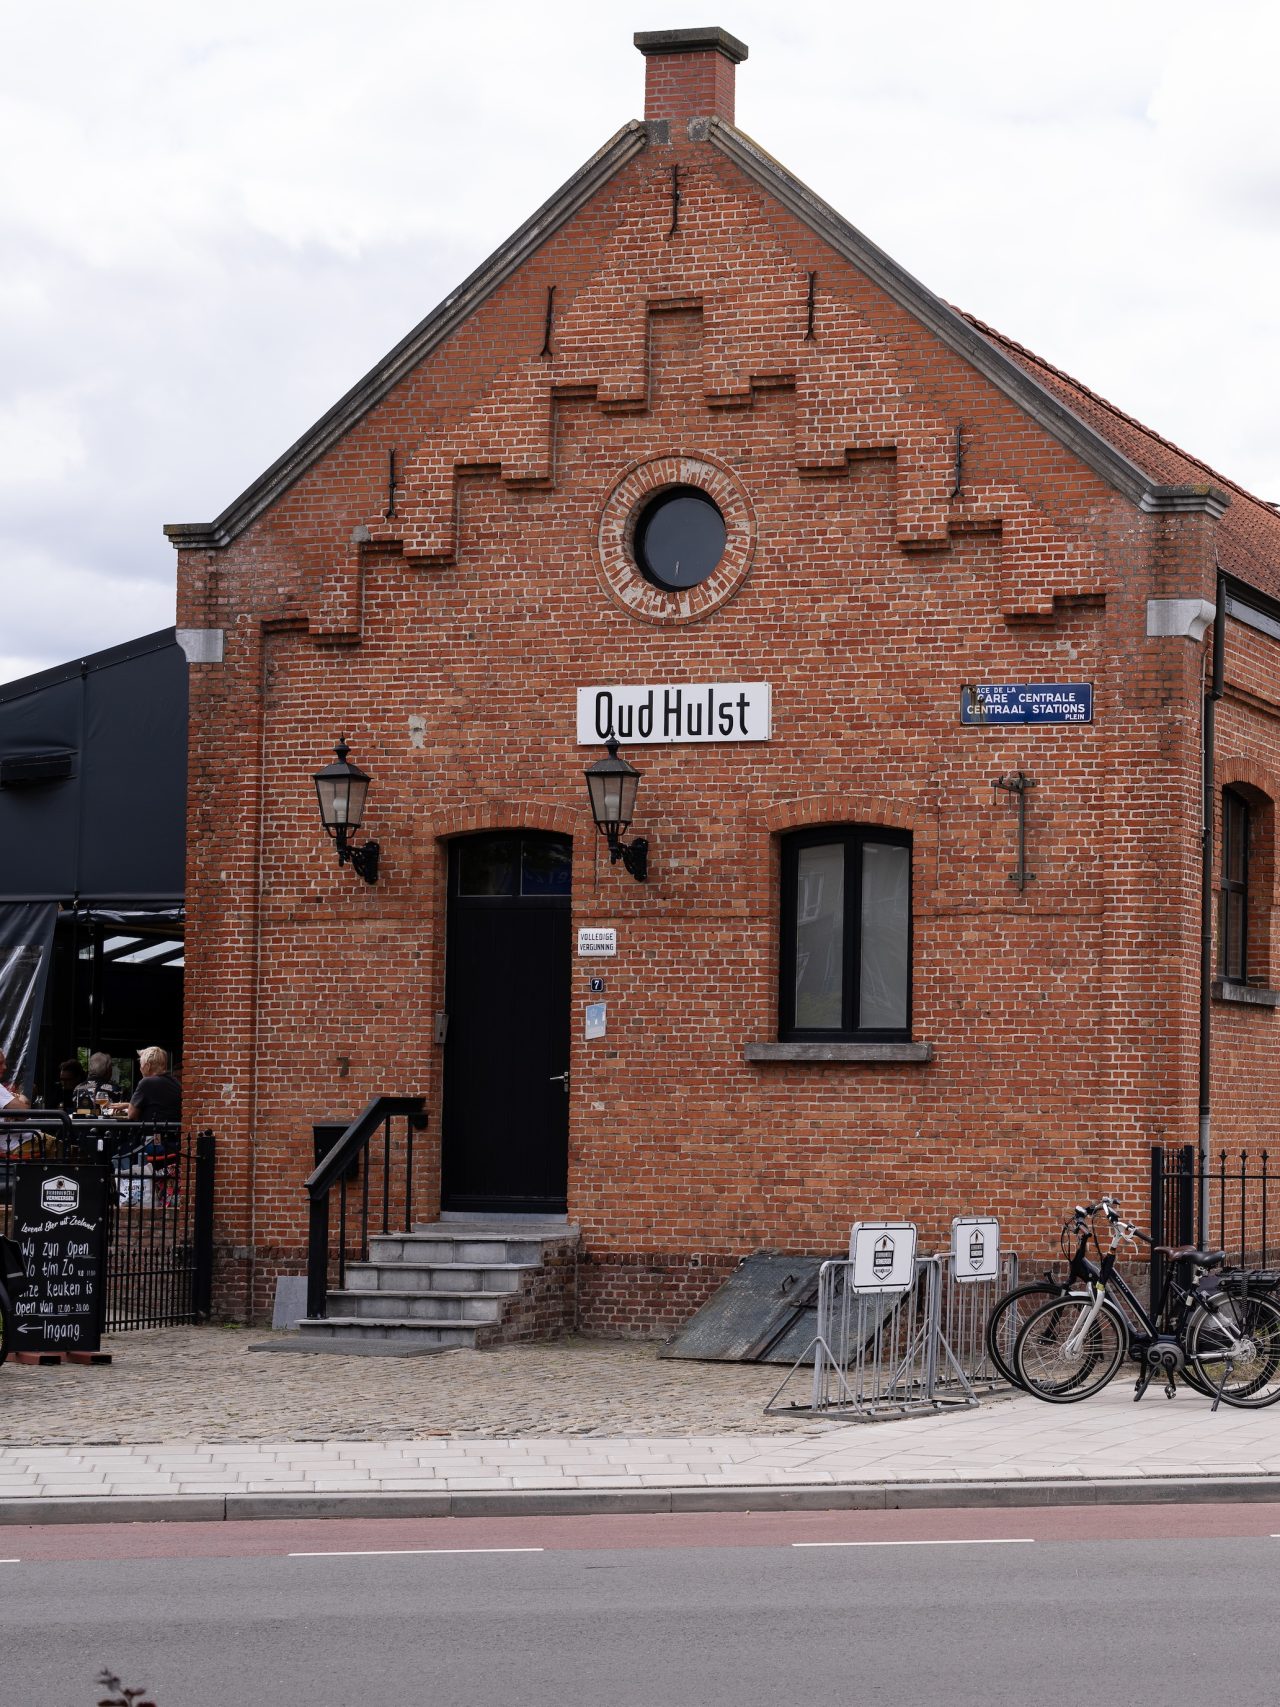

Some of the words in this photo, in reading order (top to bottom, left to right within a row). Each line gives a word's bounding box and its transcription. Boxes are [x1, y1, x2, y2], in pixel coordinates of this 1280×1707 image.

[978, 694, 1008, 703] GARE
[1018, 692, 1076, 702] CENTRALE
[595, 690, 654, 738] Oud
[664, 688, 750, 736] Hulst
[966, 704, 1025, 714] CENTRAAL
[1032, 704, 1085, 714] STATIONS
[594, 980, 599, 989] 7
[21, 1222, 43, 1233] Levend
[60, 1216, 70, 1225] uit
[69, 1216, 96, 1231] Zeeland
[68, 1240, 88, 1259] Open
[62, 1259, 74, 1276] Zo
[47, 1280, 80, 1298] keuken
[86, 1280, 92, 1294] is
[16, 1301, 36, 1317] Open
